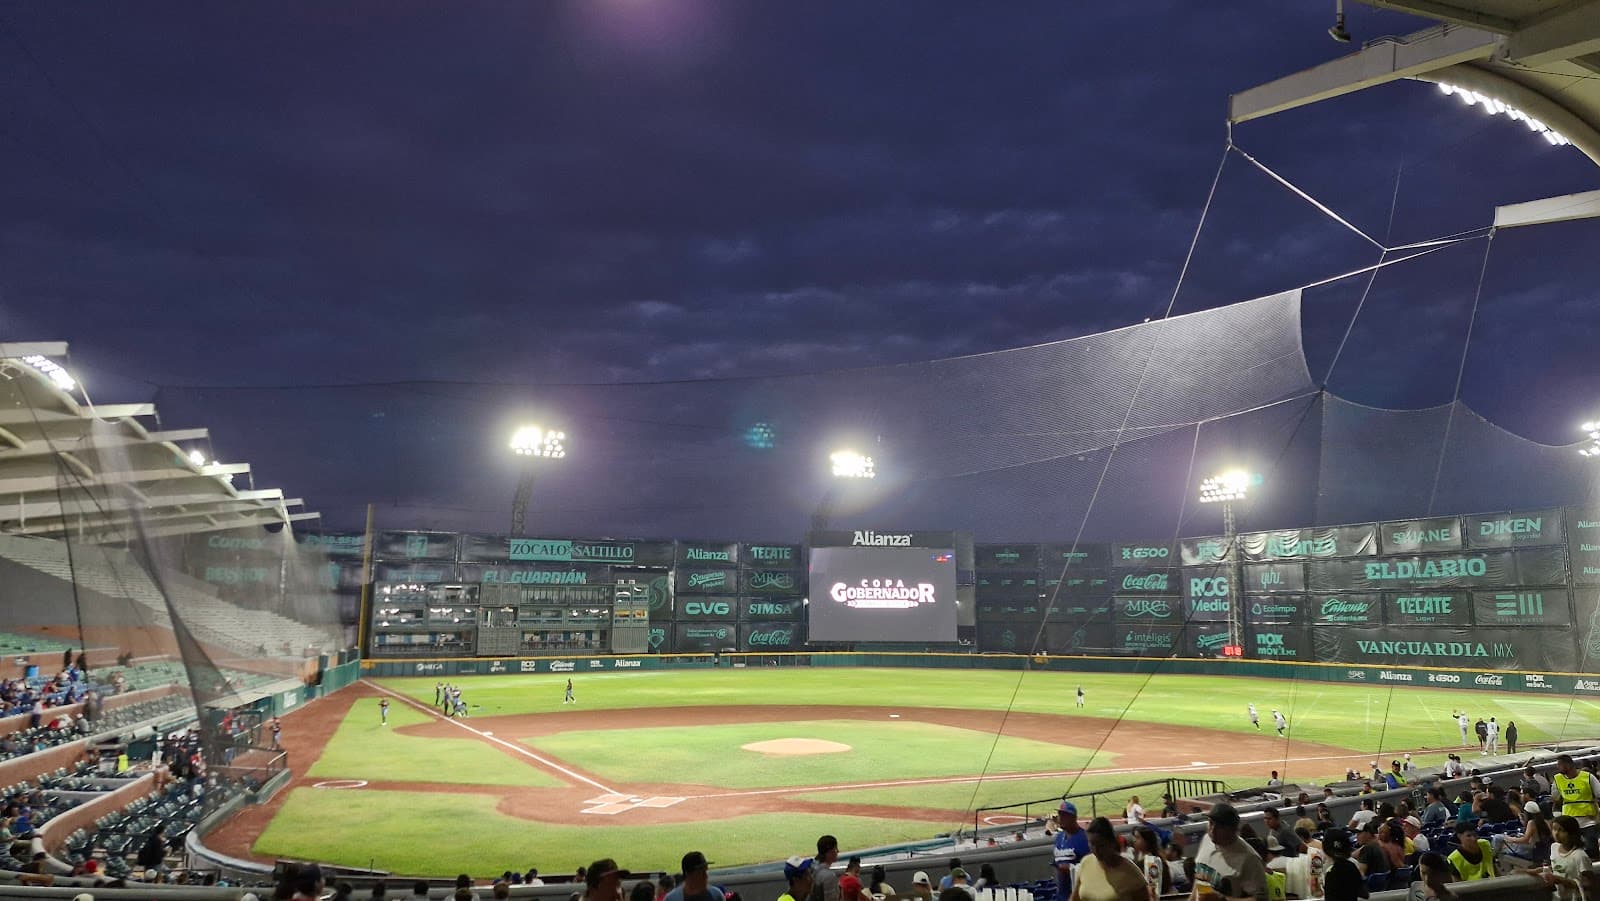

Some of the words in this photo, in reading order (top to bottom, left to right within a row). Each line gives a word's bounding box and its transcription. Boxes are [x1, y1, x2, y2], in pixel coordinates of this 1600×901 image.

[852, 531, 913, 546] Alianza
[574, 546, 634, 559] SALTILLO
[687, 549, 729, 560] Alianza
[751, 546, 792, 560] TECATE
[1132, 547, 1169, 558] G500
[861, 579, 905, 588] COPA
[1122, 573, 1169, 590] Coca-Cola
[1190, 576, 1229, 597] RCG
[830, 582, 936, 603] GOBERNADOR
[685, 602, 730, 615] CVG
[749, 603, 793, 615] SIMSA
[1191, 600, 1230, 612] Media
[1397, 597, 1452, 614] TECATE
[749, 629, 793, 646] Coca-Cola
[1356, 641, 1489, 657] VANGUARDIA
[1494, 643, 1514, 658] MX
[615, 659, 642, 668] Alianza
[1380, 671, 1413, 681] Alianza
